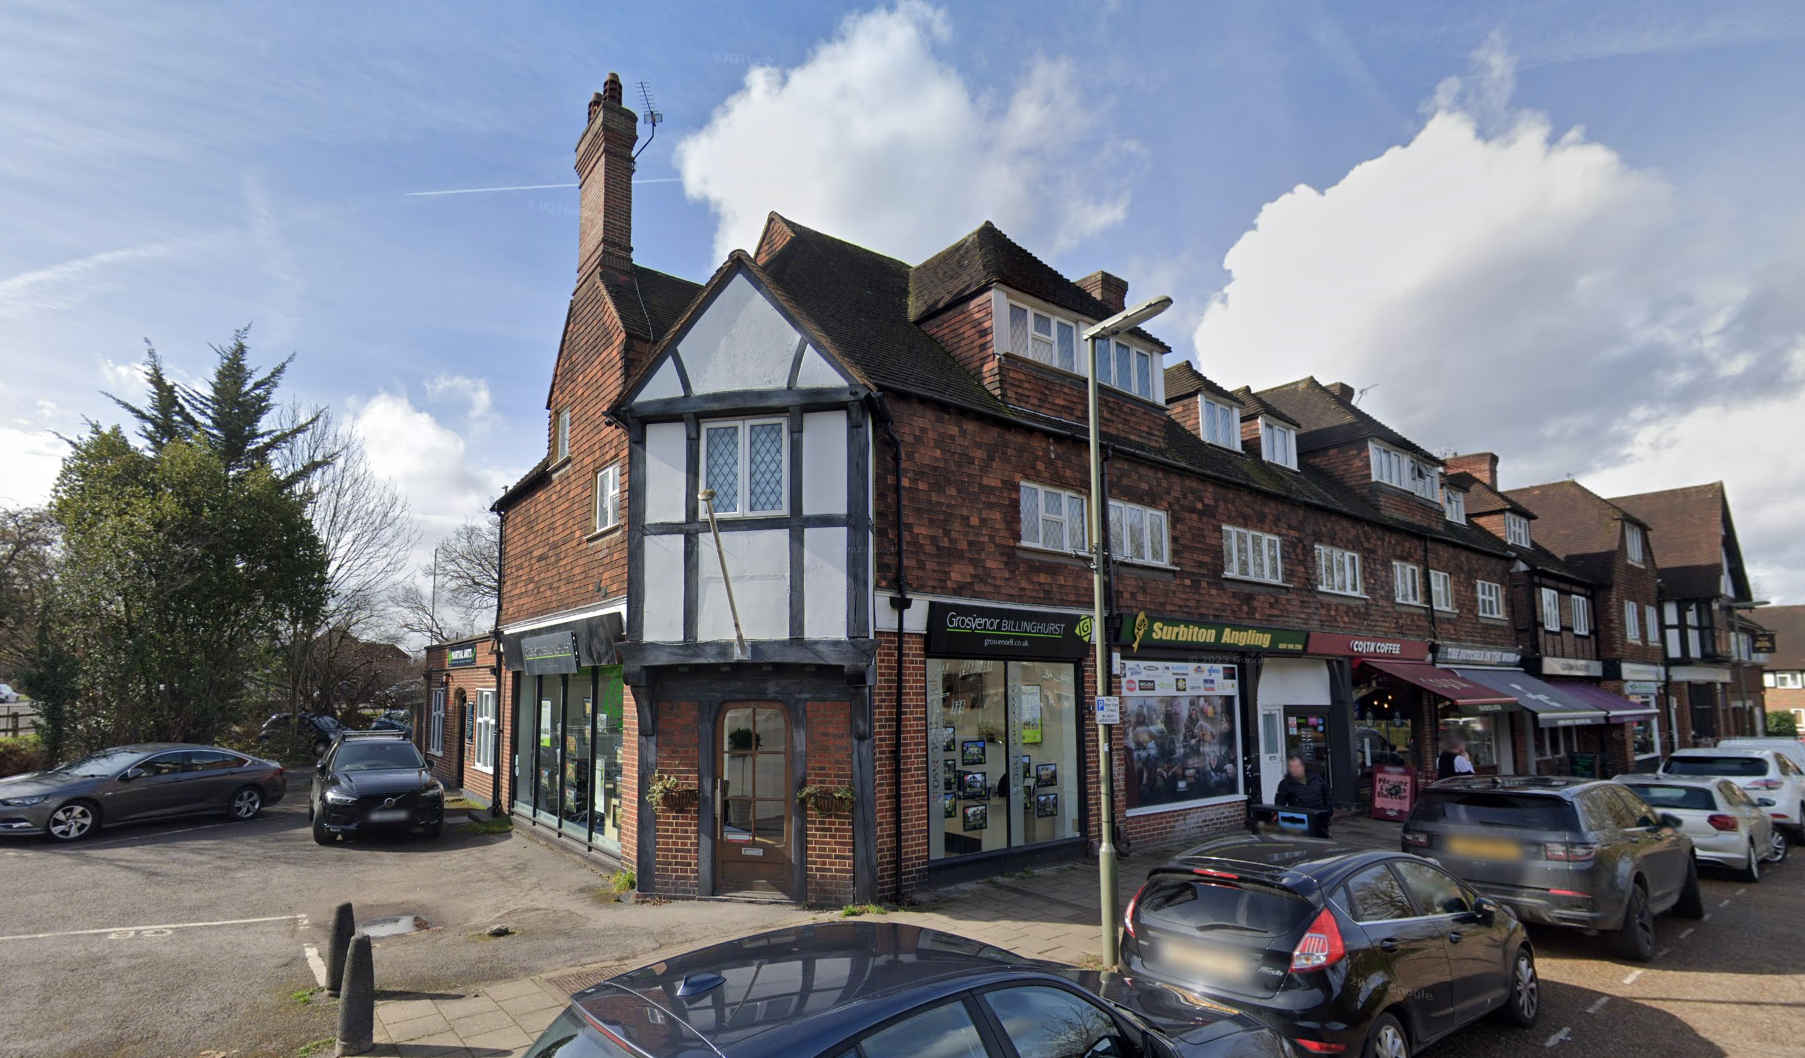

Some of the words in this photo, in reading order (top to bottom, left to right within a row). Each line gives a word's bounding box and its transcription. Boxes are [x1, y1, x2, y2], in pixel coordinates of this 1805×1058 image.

[1001, 619, 1065, 635] BILLINGHURST
[1152, 621, 1216, 643] Surbiton
[1221, 627, 1272, 648] Angling
[1376, 642, 1401, 654] COFFEE
[1378, 777, 1408, 787] Never
[1377, 790, 1408, 801] Better
